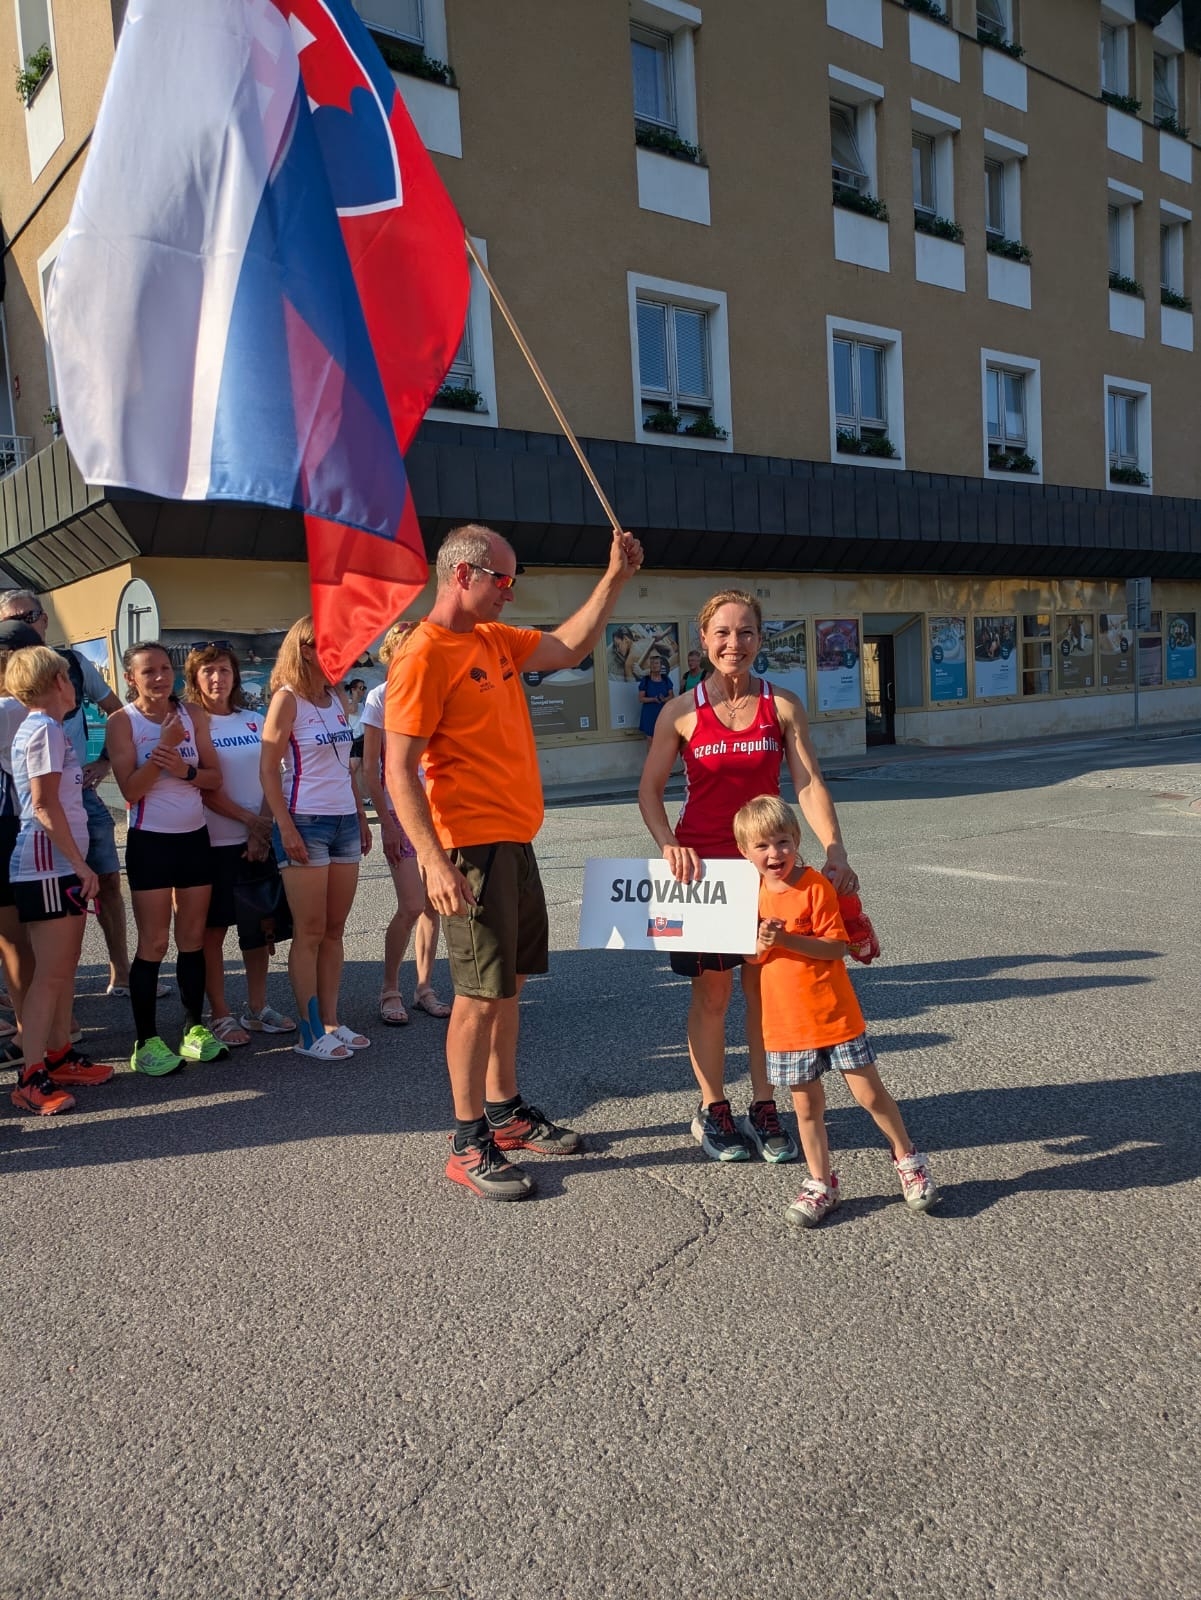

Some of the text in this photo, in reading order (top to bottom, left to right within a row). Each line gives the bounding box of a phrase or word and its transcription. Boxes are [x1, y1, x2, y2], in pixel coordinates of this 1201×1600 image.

[694, 736, 779, 759] czech republic
[610, 878, 728, 905] SLOVAKIA
